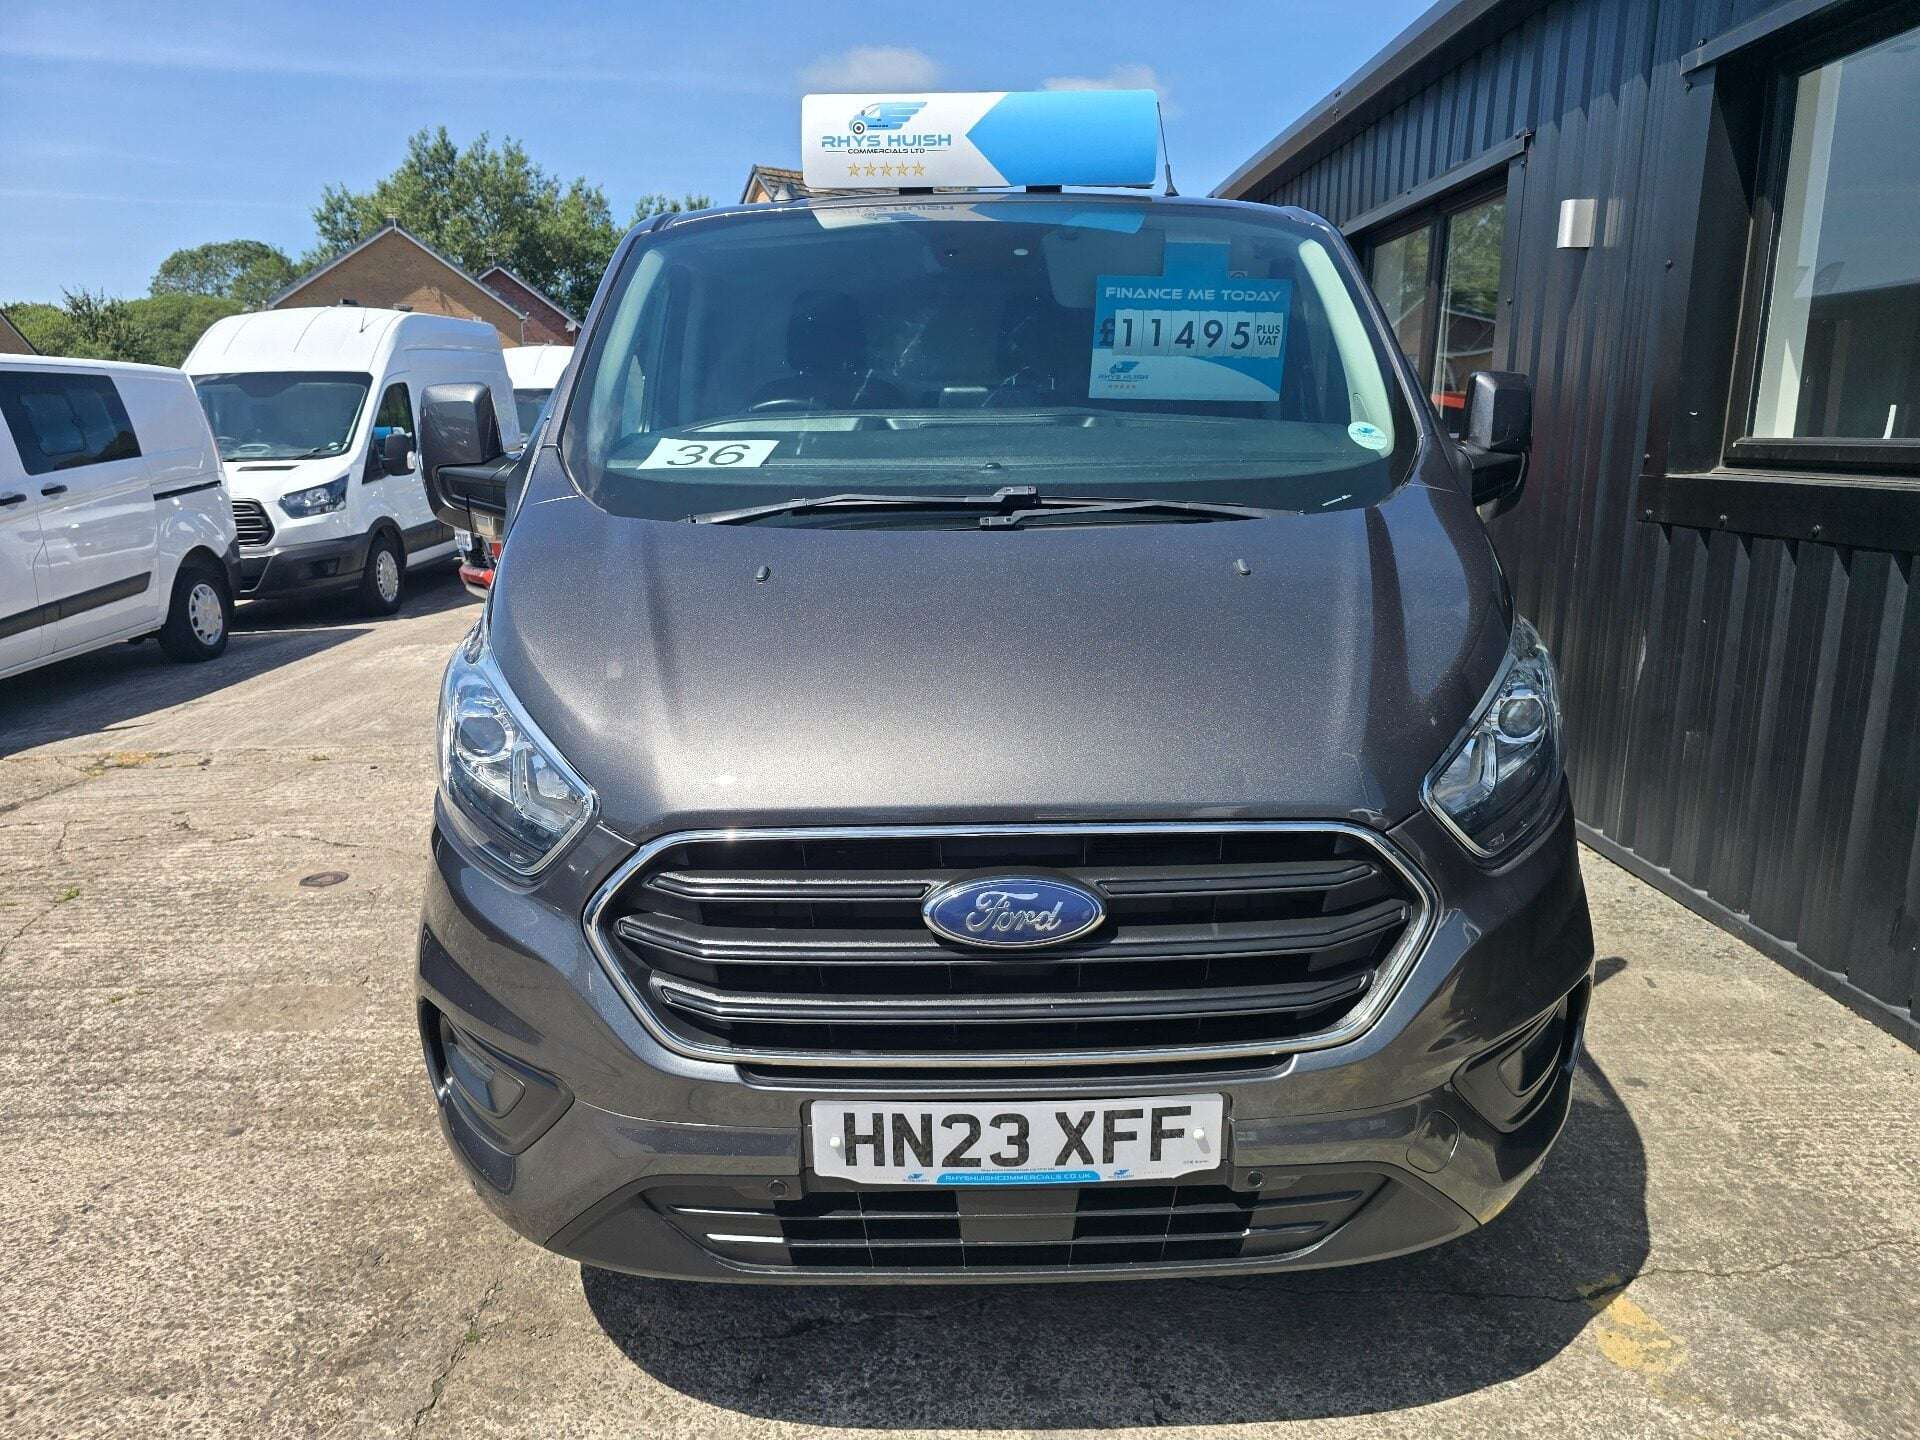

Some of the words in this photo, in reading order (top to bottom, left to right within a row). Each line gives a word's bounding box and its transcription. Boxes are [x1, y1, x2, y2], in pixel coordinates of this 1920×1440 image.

[821, 134, 881, 148] RHYS
[887, 133, 952, 147] HUISH
[1105, 286, 1184, 300] FINANCE
[1187, 288, 1216, 300] ME
[1220, 289, 1282, 302] TODAY
[1256, 324, 1281, 335] PLUS
[1257, 336, 1278, 346] VAT
[666, 444, 751, 466] 36
[965, 890, 1064, 933] Ford
[842, 1110, 1031, 1168] HN23
[1054, 1105, 1193, 1167] XFF
